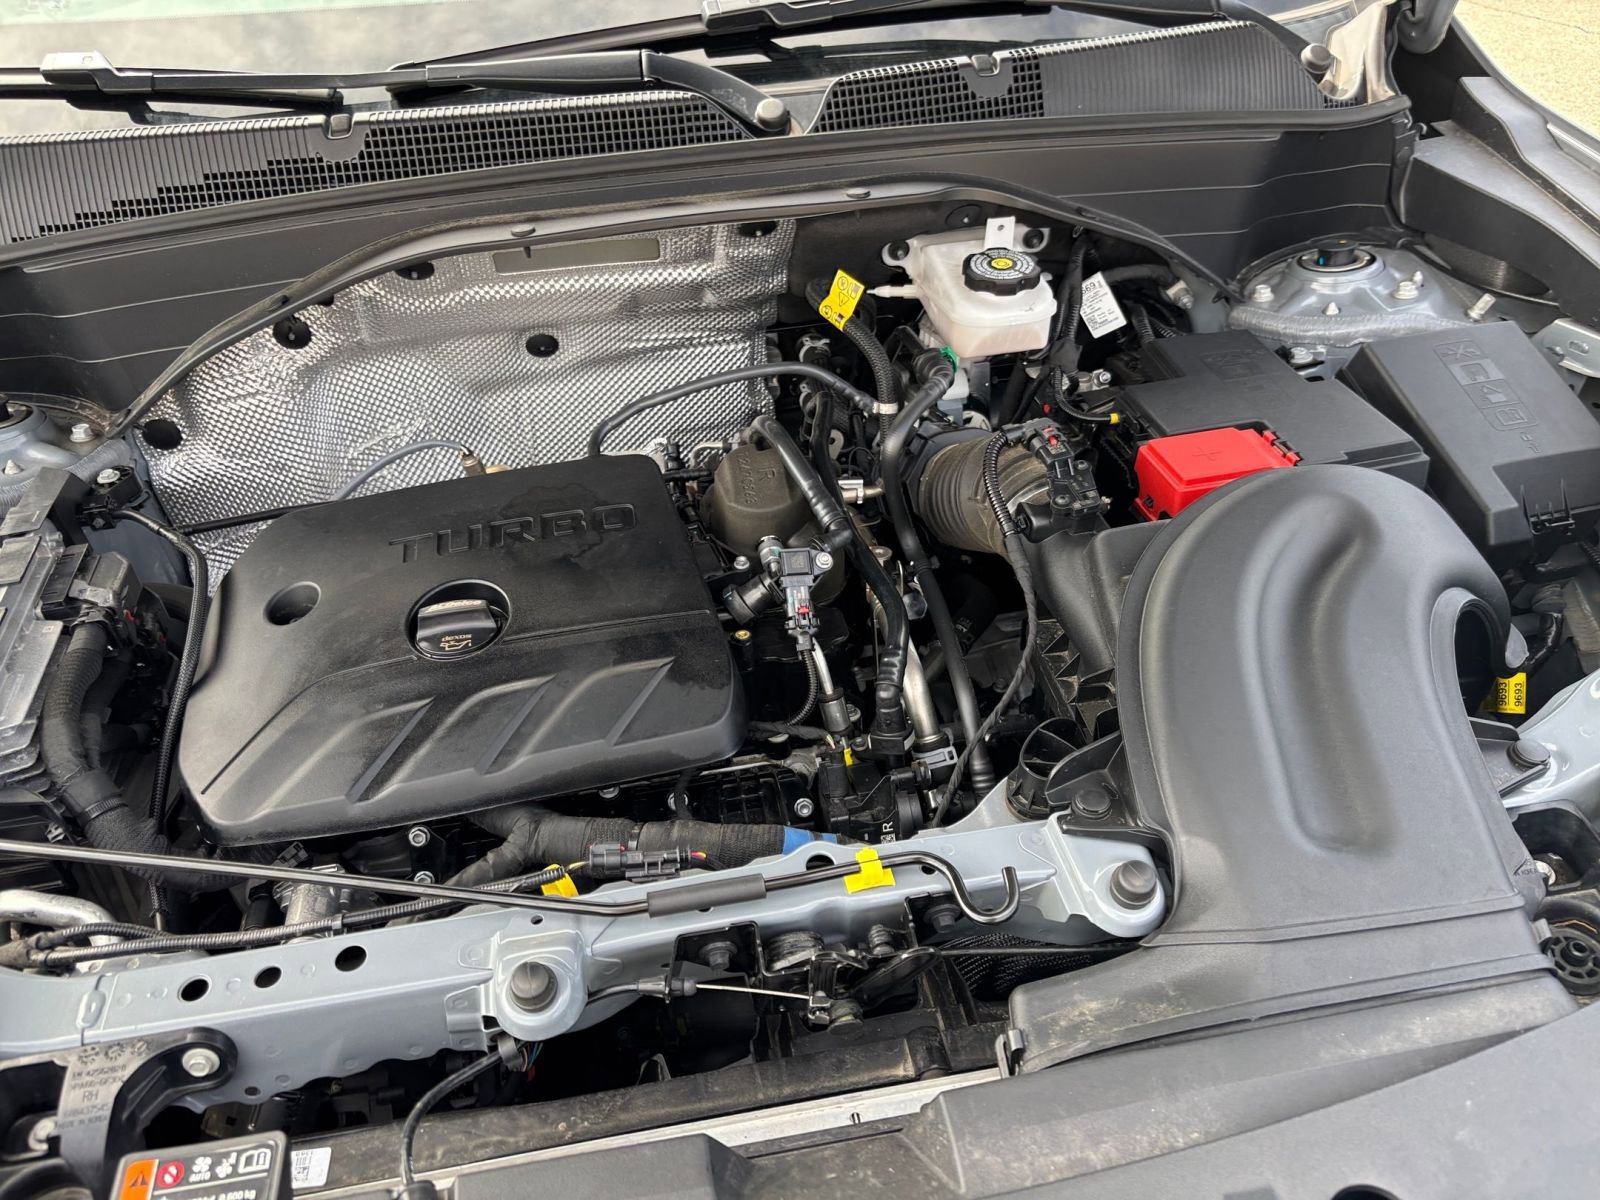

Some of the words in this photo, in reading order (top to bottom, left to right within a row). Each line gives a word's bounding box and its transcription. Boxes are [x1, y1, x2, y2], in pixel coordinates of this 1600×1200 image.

[758, 467, 776, 481] R
[388, 503, 637, 563] TURBO
[441, 634, 472, 642] dexos
[1498, 682, 1507, 706] 9693
[1514, 683, 1523, 707] 9693
[882, 821, 893, 832] R
[83, 1090, 99, 1103] RH
[189, 1171, 210, 1183] AUTO
